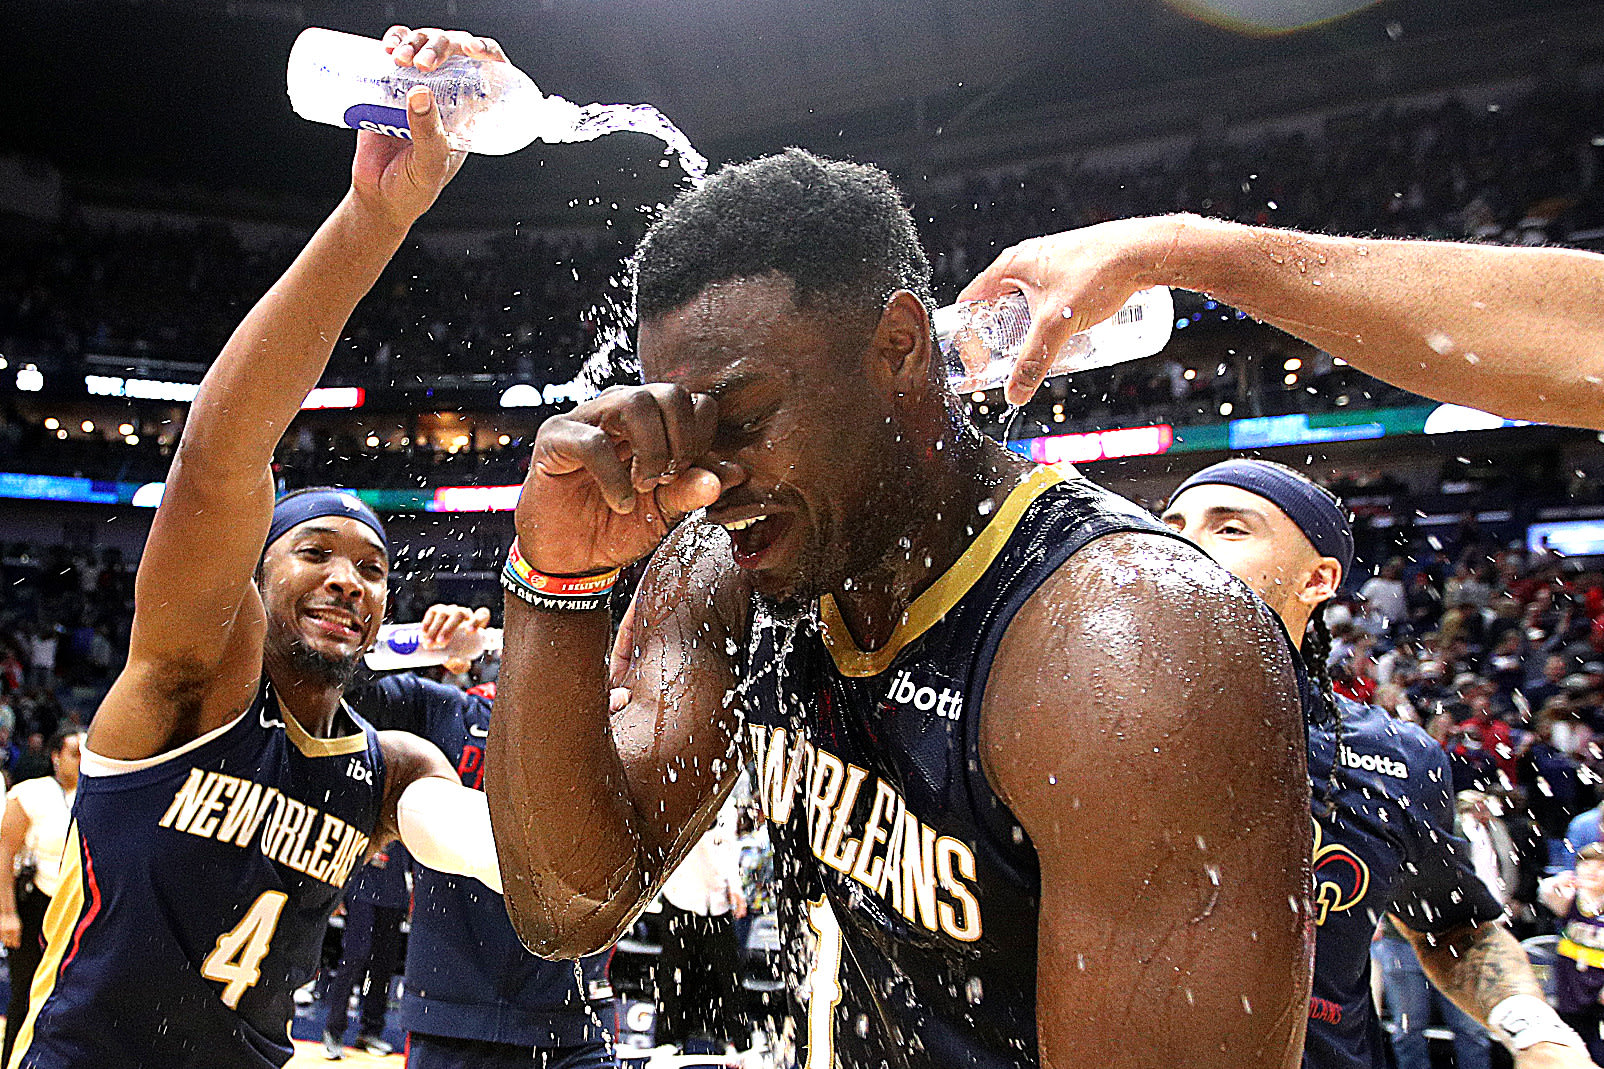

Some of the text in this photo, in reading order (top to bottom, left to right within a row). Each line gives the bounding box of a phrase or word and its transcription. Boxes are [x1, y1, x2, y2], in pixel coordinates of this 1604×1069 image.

[1340, 744, 1408, 779] ibotta
[158, 767, 370, 889] NEW ORLEANS
[201, 889, 289, 1011] 4
[804, 892, 843, 1069] 1
